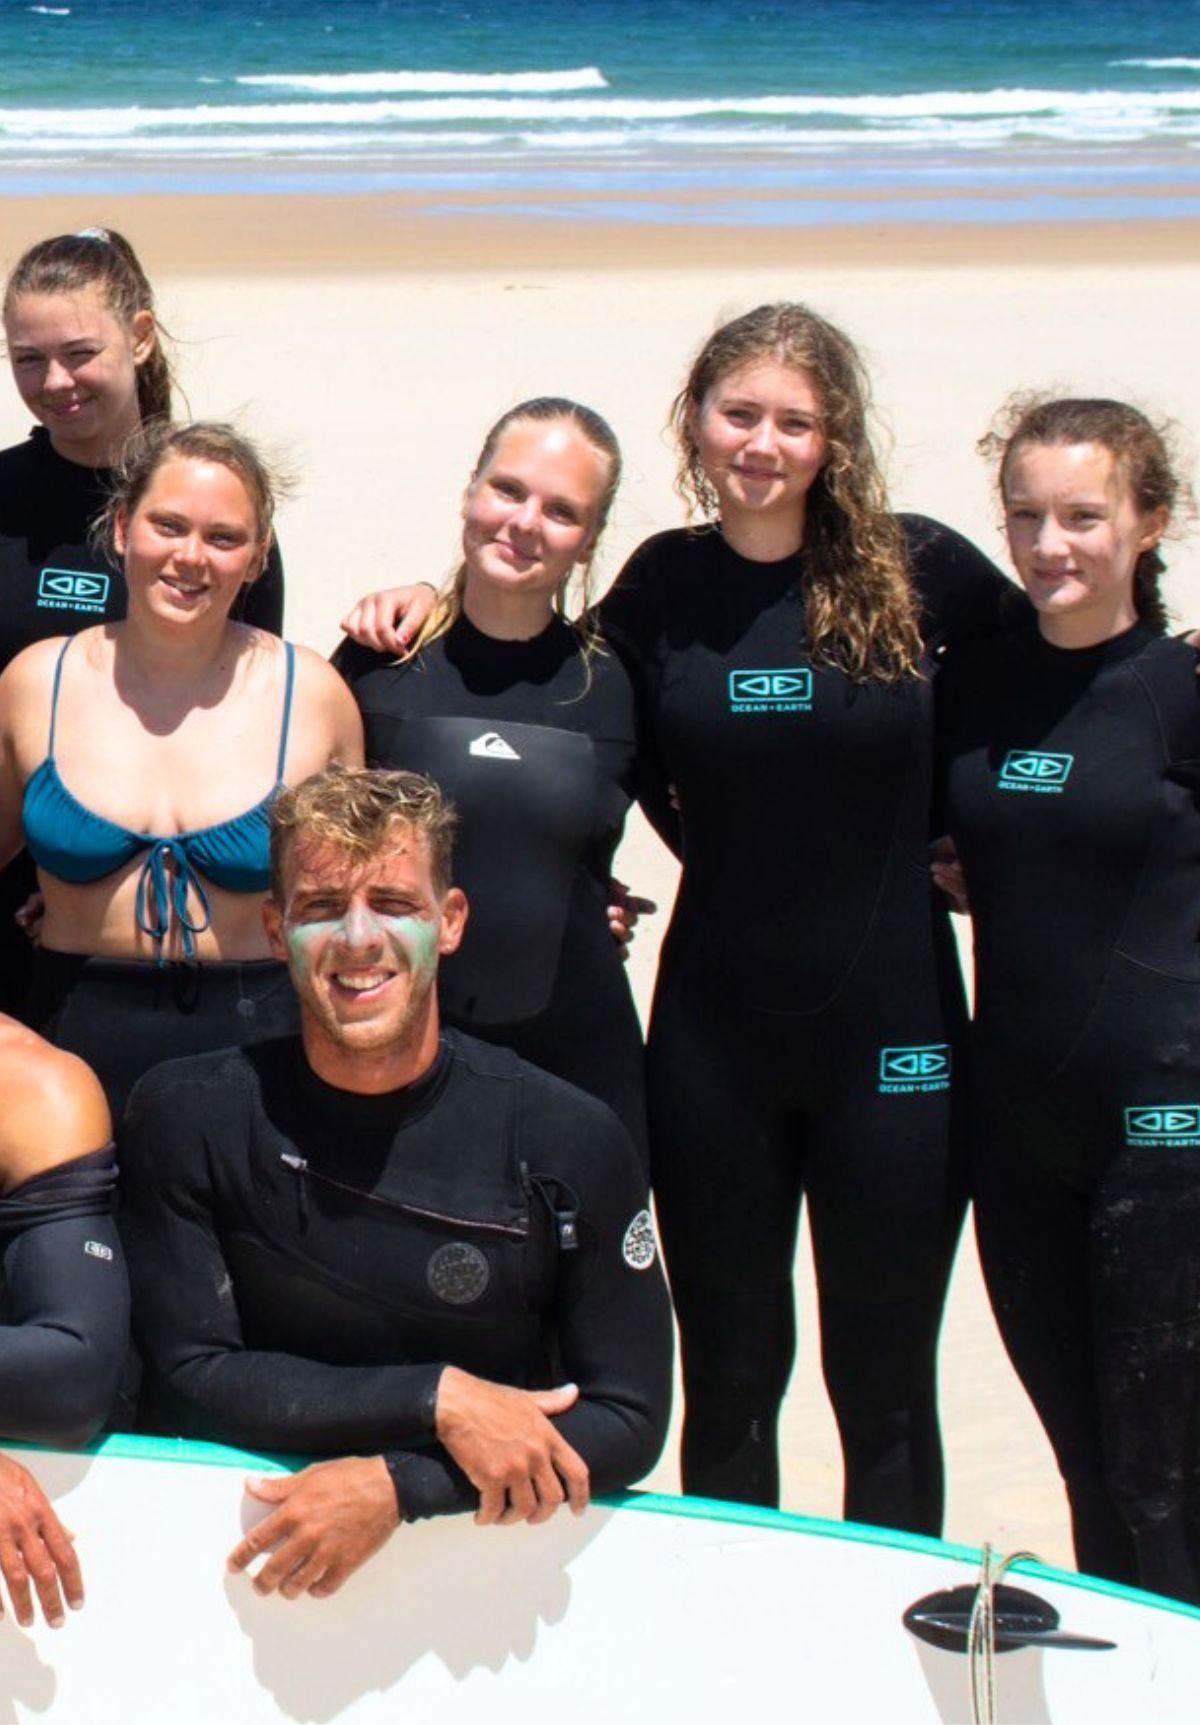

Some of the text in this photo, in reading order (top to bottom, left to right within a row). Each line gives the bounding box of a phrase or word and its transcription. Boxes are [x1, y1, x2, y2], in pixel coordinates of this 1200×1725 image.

[37, 599, 68, 609] OCEAN
[75, 603, 105, 614] EARTH
[730, 703, 768, 713] OCEAN
[775, 703, 812, 713] EARTH
